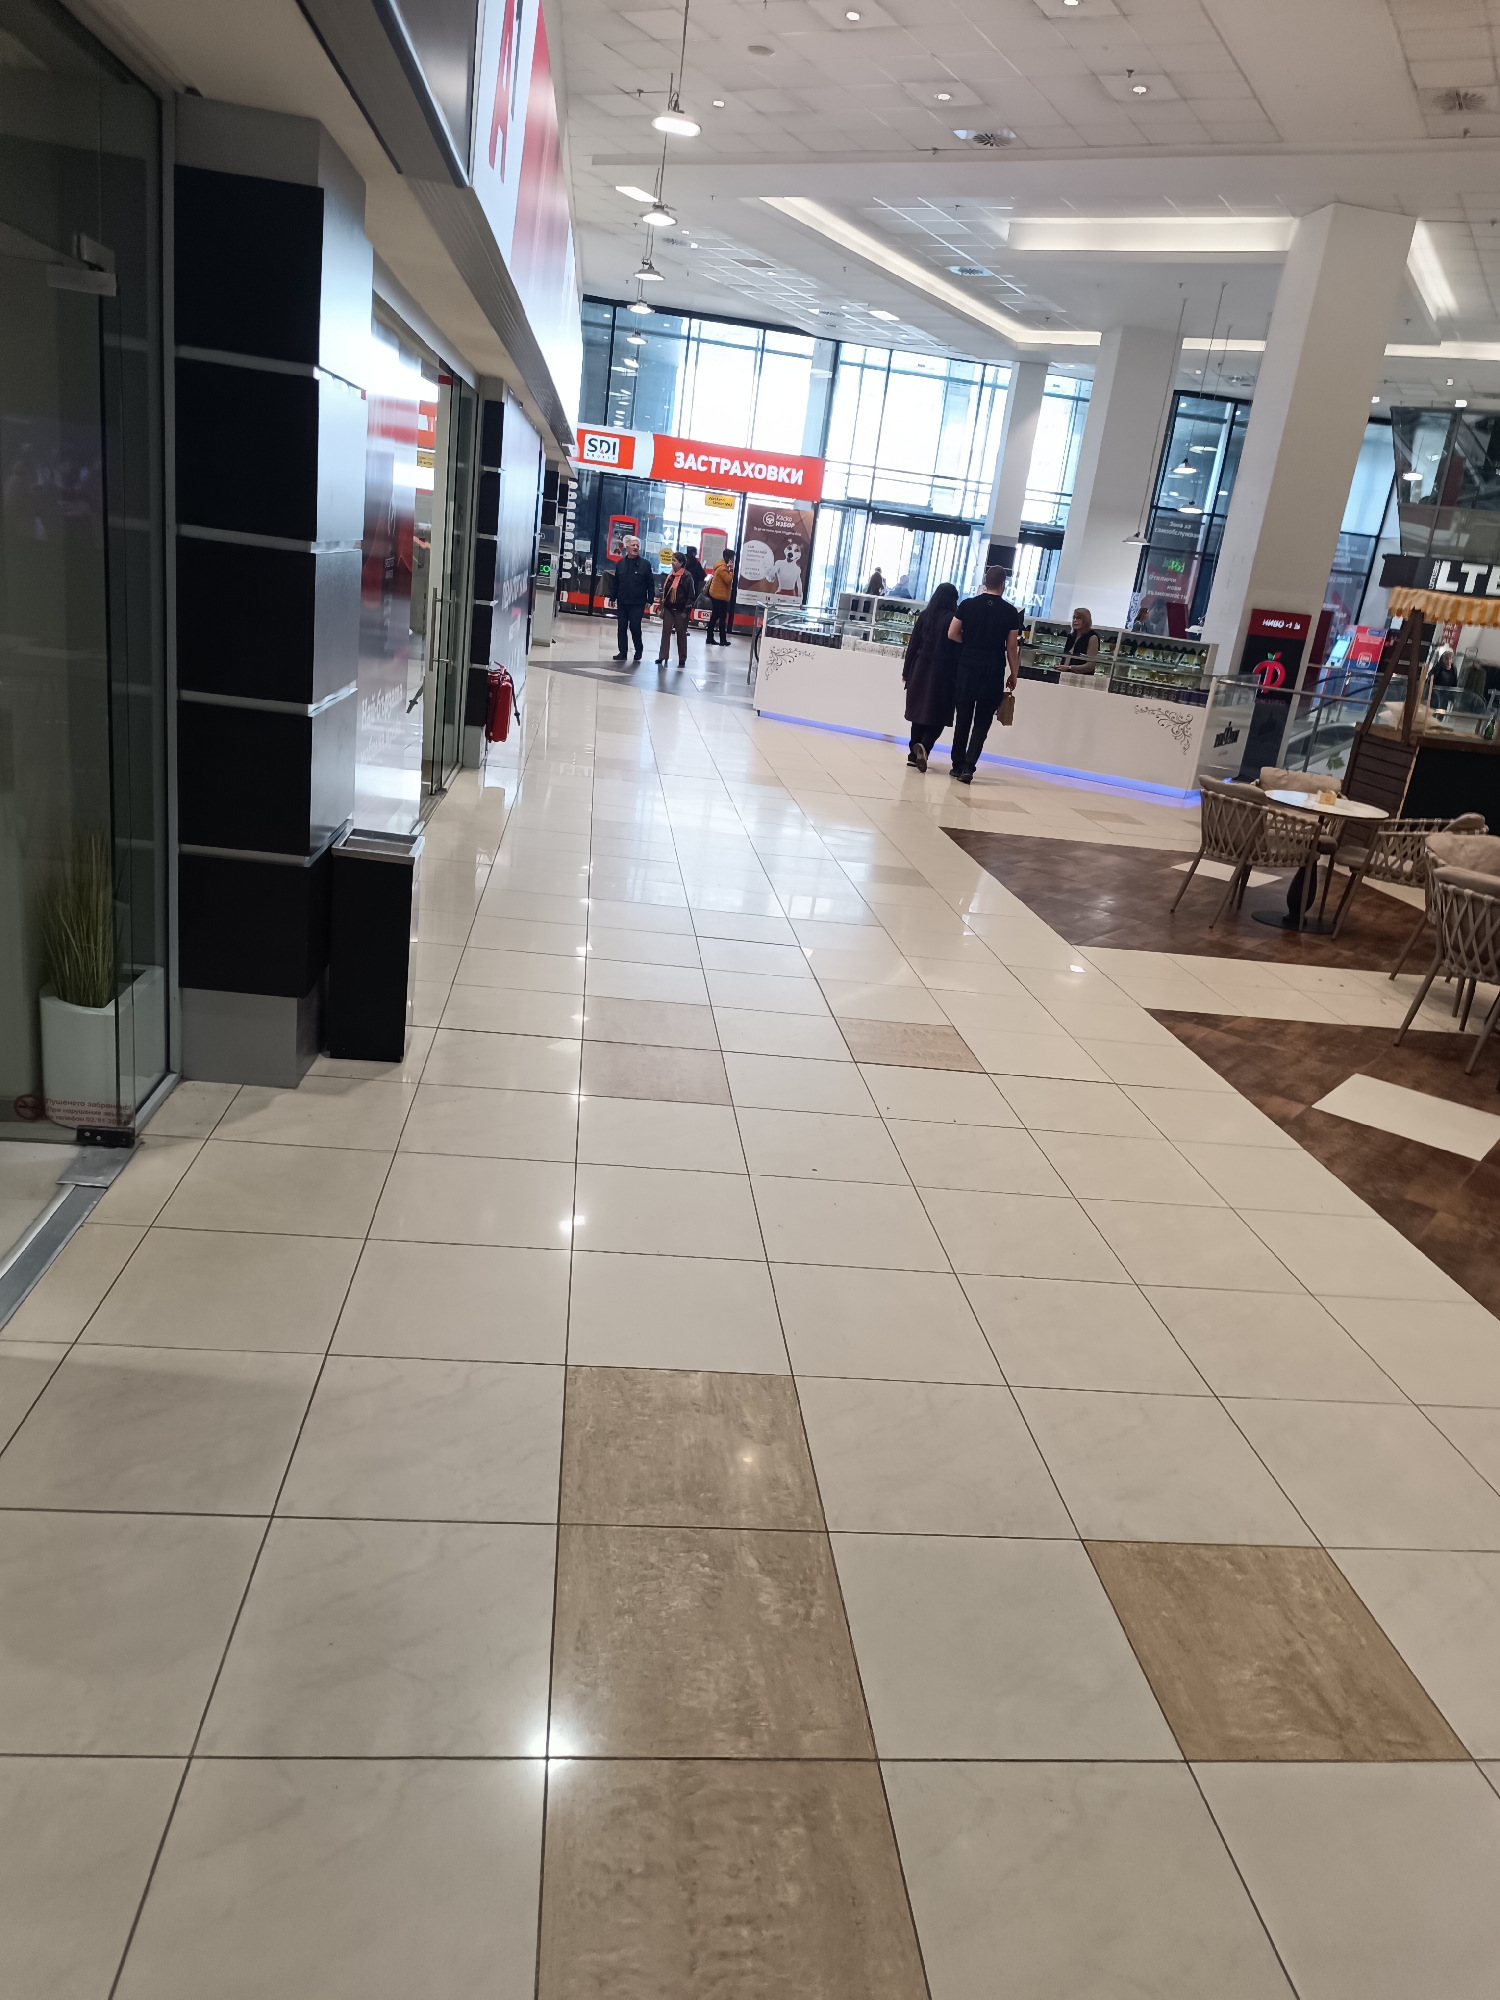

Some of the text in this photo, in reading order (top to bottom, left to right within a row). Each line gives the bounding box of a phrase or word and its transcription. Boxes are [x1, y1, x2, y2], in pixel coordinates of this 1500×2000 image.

[587, 437, 617, 455] SDI
[673, 451, 804, 486] ЗАСТРАХОВКИ
[45, 1098, 85, 1107] Пушенето
